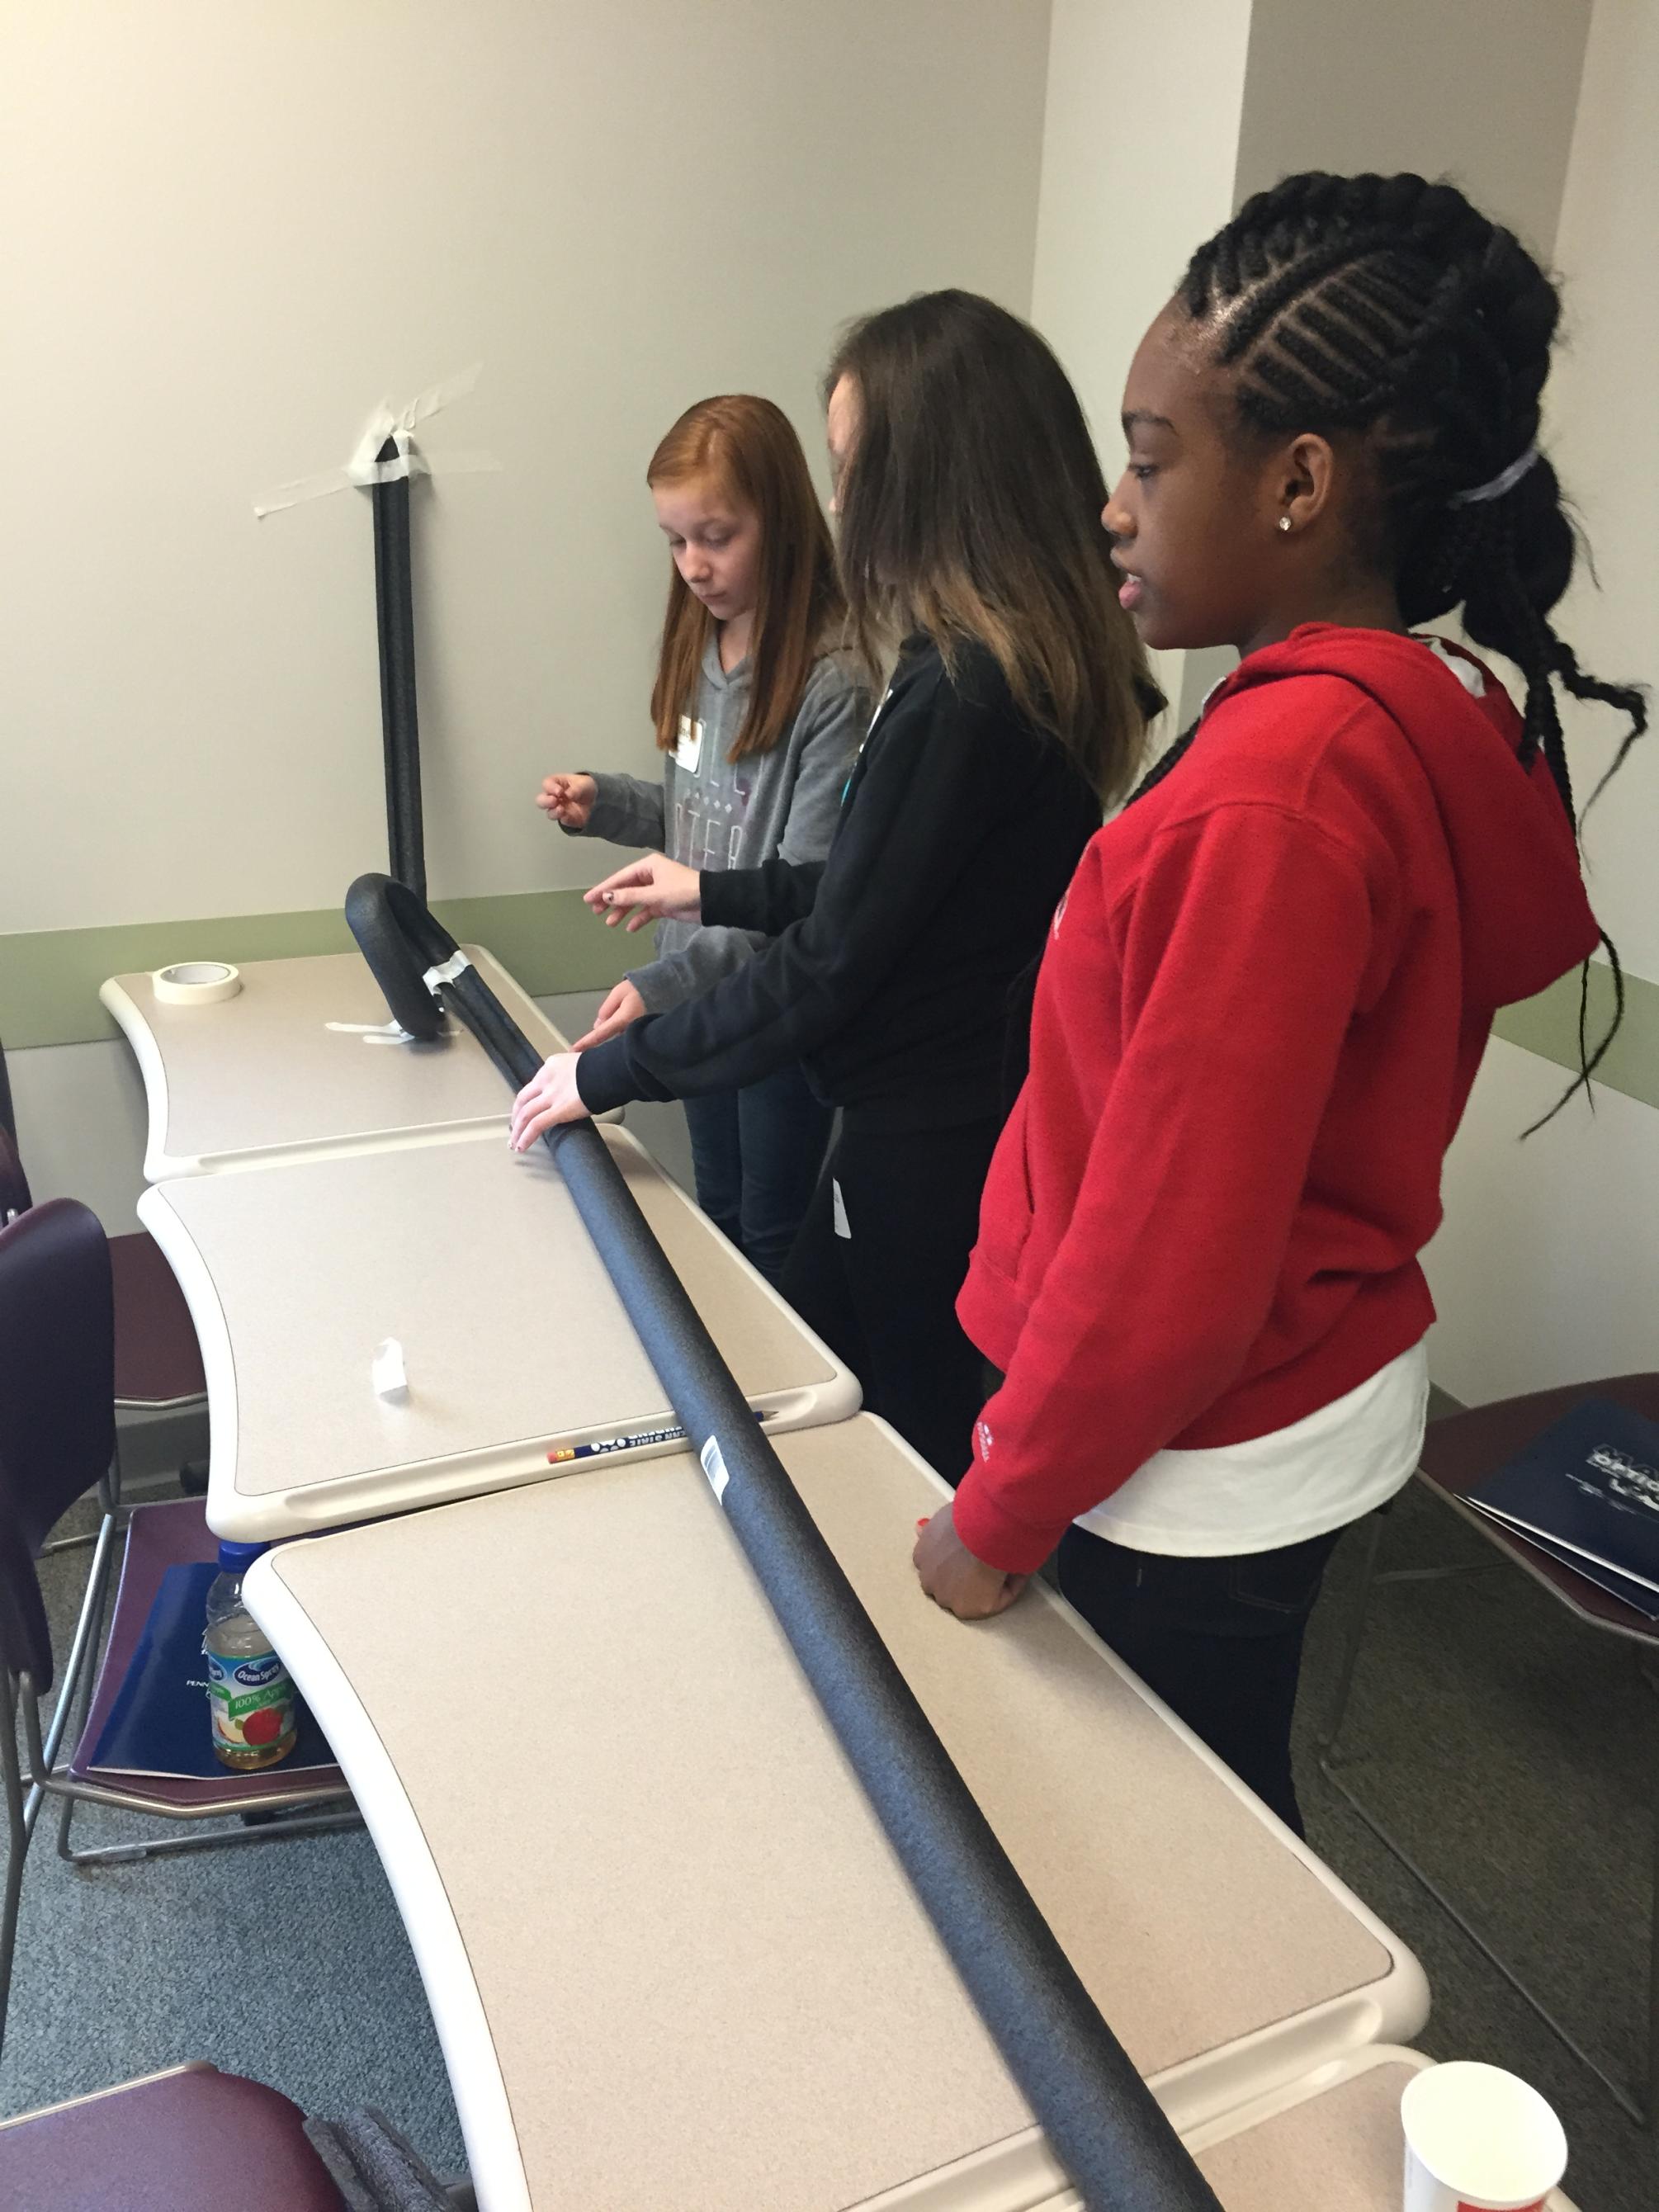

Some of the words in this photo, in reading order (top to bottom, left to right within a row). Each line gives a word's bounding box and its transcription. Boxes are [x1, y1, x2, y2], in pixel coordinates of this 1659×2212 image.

[238, 1670, 261, 1682] Ocean
[260, 1662, 280, 1680] Spray
[234, 1694, 261, 1709] 100%
